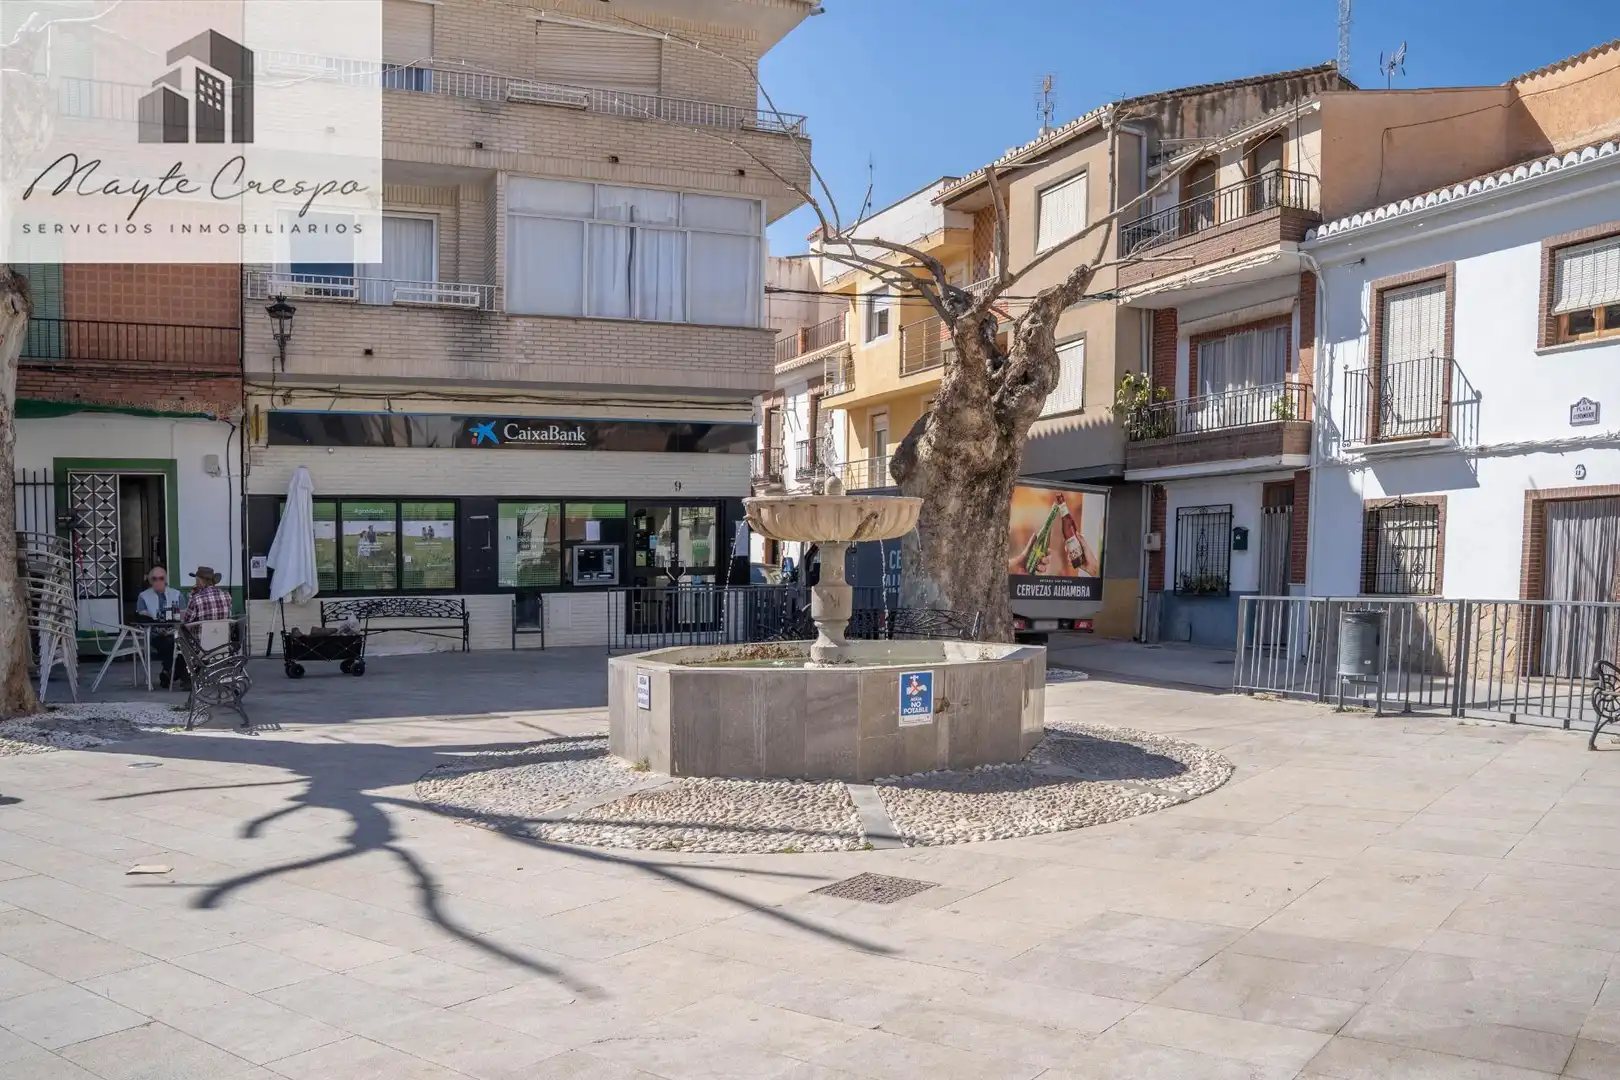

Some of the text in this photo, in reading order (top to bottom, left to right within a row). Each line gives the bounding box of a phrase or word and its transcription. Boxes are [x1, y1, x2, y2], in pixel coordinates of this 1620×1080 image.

[503, 423, 586, 442] CaixaBank
[674, 480, 682, 492] 9
[1016, 584, 1091, 598] CERVEZAS ALHAMBRA
[903, 706, 929, 714] POTABLE
